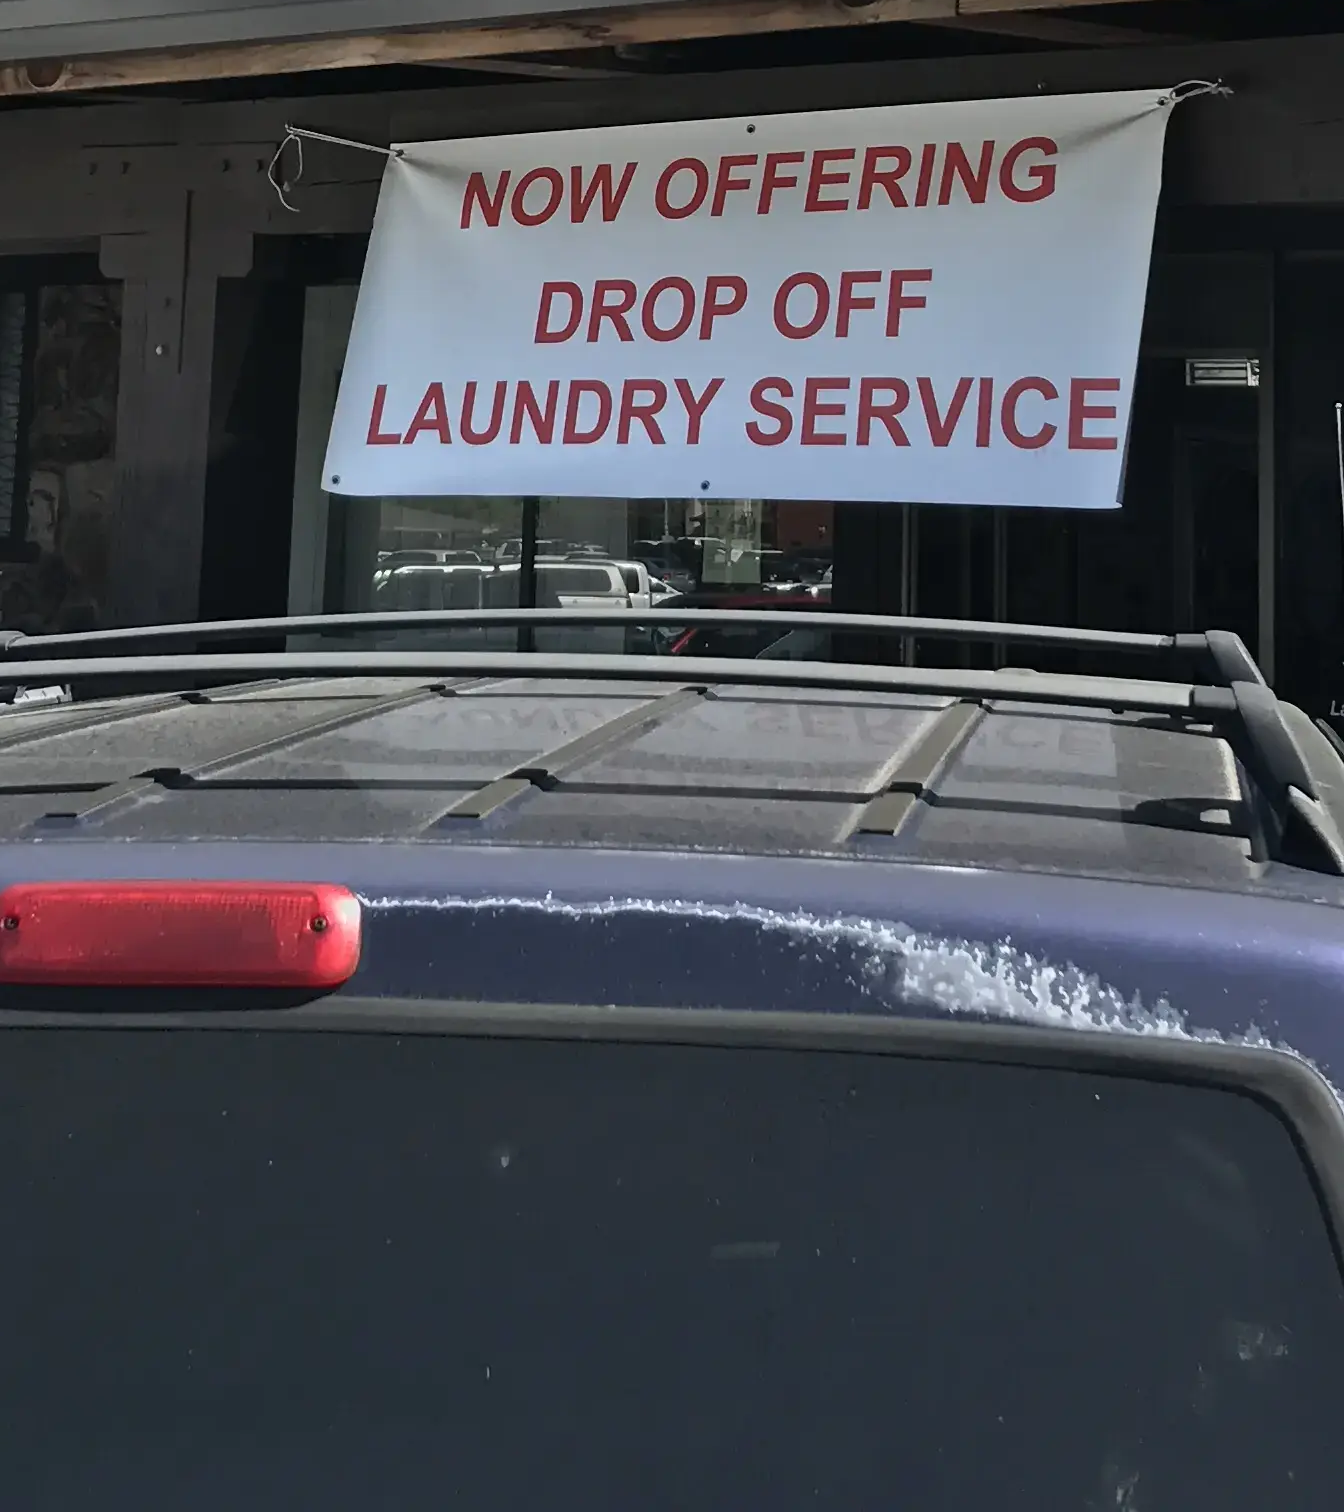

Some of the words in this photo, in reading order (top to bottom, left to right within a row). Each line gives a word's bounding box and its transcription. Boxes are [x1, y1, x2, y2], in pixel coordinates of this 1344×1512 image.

[459, 161, 638, 230] NOW
[655, 136, 1058, 220] OFFERING
[534, 276, 748, 344] DROP
[773, 269, 933, 340] OFF
[366, 378, 725, 447] LAUNDRY
[745, 376, 1122, 451] SERVICE
